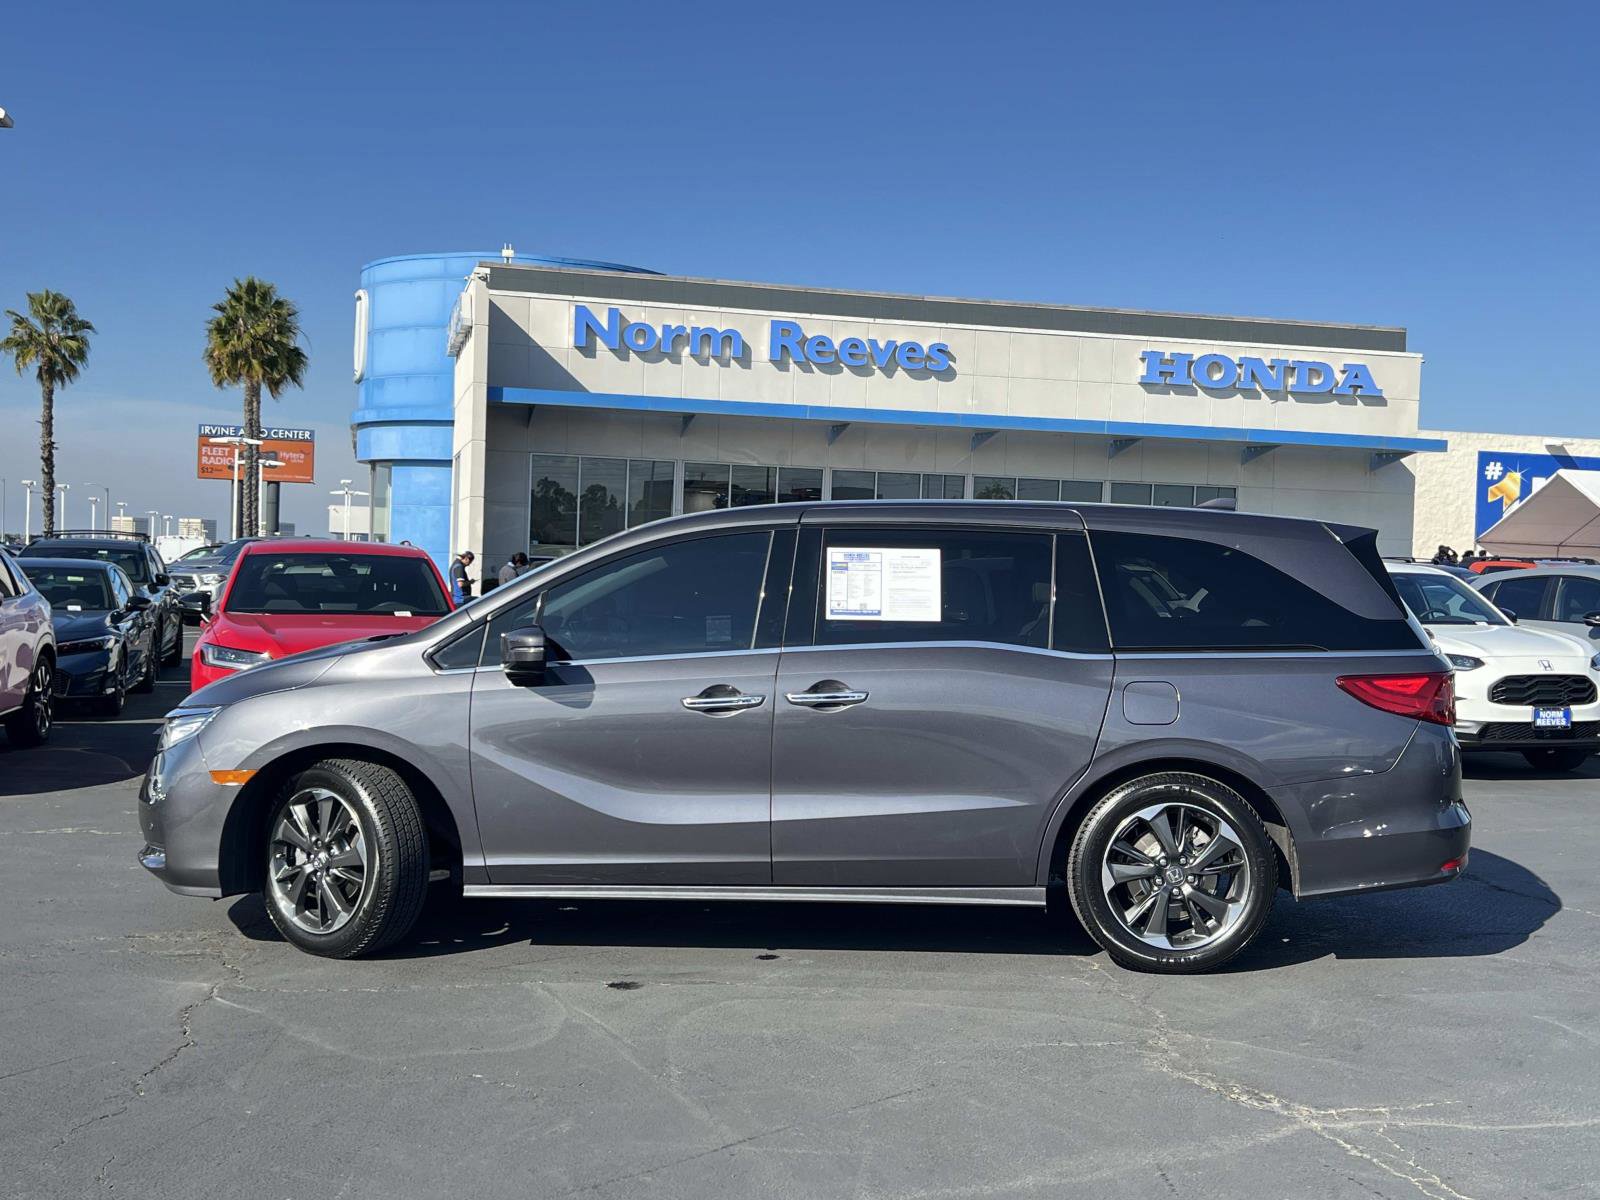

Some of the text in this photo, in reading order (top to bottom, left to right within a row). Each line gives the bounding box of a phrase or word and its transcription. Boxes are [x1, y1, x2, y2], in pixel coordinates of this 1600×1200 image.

[573, 304, 951, 371] Norm Reeves
[1138, 350, 1383, 397] HONDA
[200, 425, 311, 440] IRVINE AO CENTER
[201, 447, 230, 456] FLEET
[201, 456, 235, 465] RADIO
[1539, 711, 1564, 719] NORM
[1536, 718, 1567, 726] REEVES
